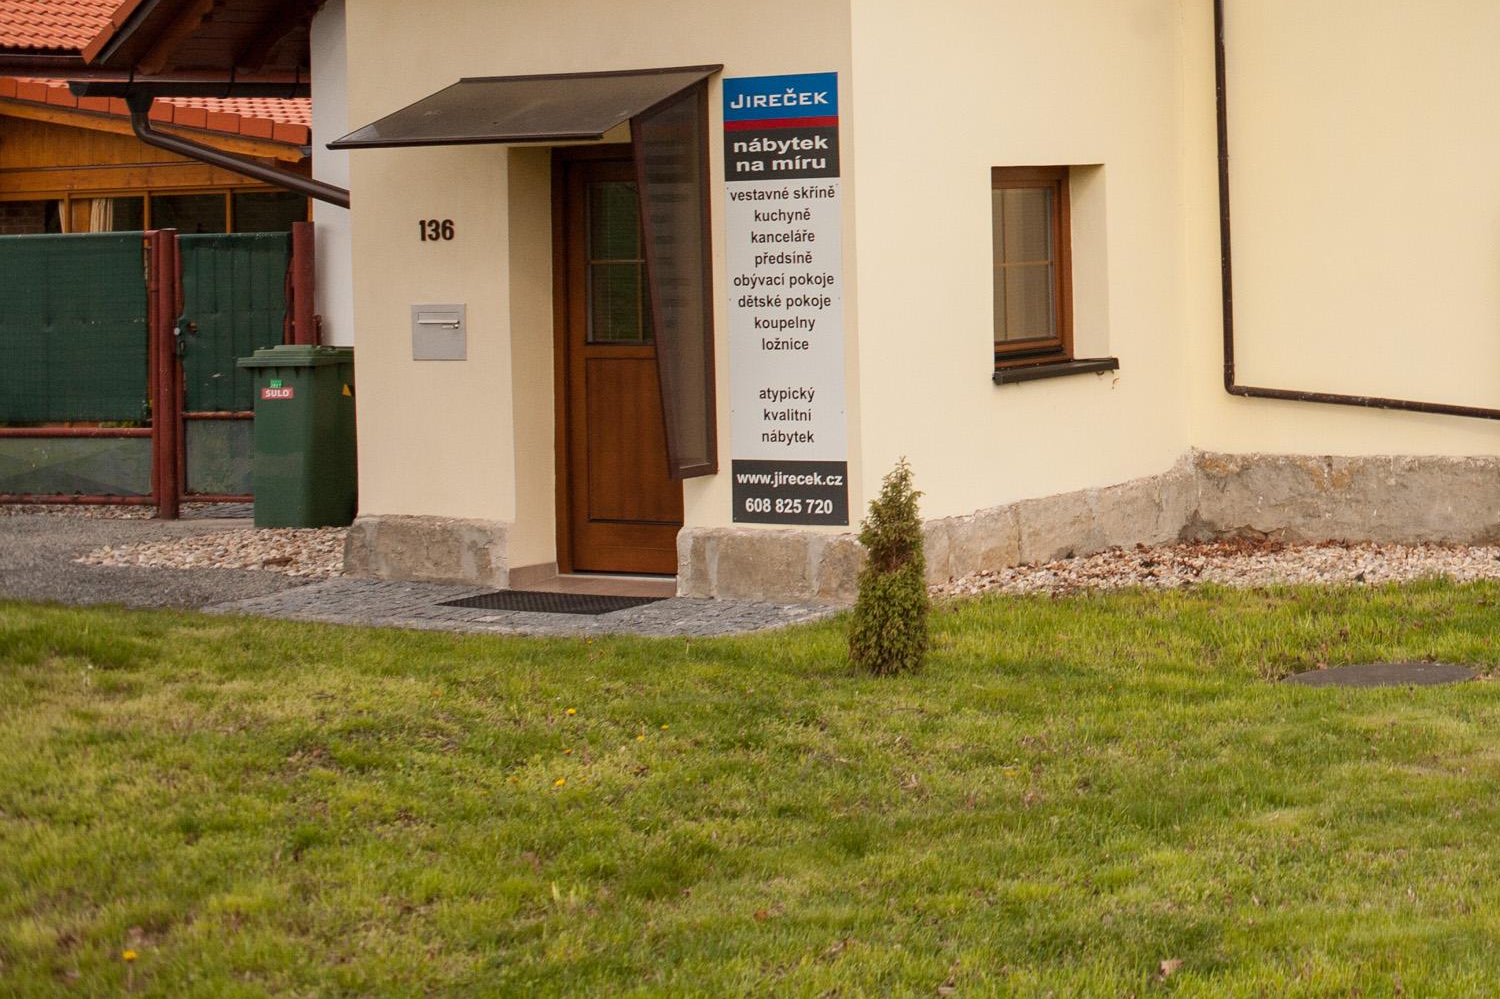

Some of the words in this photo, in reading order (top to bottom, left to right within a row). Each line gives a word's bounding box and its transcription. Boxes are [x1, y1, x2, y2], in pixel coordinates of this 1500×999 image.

[730, 88, 829, 109] JIREČEK
[733, 135, 829, 155] nábytek
[736, 159, 765, 173] na
[772, 156, 827, 171] míru
[730, 187, 789, 202] vestavné
[793, 185, 835, 199] skříně
[754, 207, 811, 224] kuchyně
[418, 219, 455, 241] 136
[751, 229, 815, 244] kanceláře
[755, 251, 813, 268] předsíně
[733, 274, 785, 289] obývací
[789, 273, 835, 288] pokoje
[738, 295, 782, 308] dětské
[786, 295, 831, 308] pokoje
[754, 316, 816, 332] koupelny
[762, 337, 809, 351] ložnice
[265, 389, 290, 398] SULO
[759, 386, 815, 403] atypický
[763, 408, 812, 422] kvalitní
[761, 429, 815, 446] nábytek
[736, 471, 843, 488] www.jirecek.cz
[745, 498, 772, 513] 608
[775, 499, 802, 514] 825
[806, 499, 833, 515] 720
